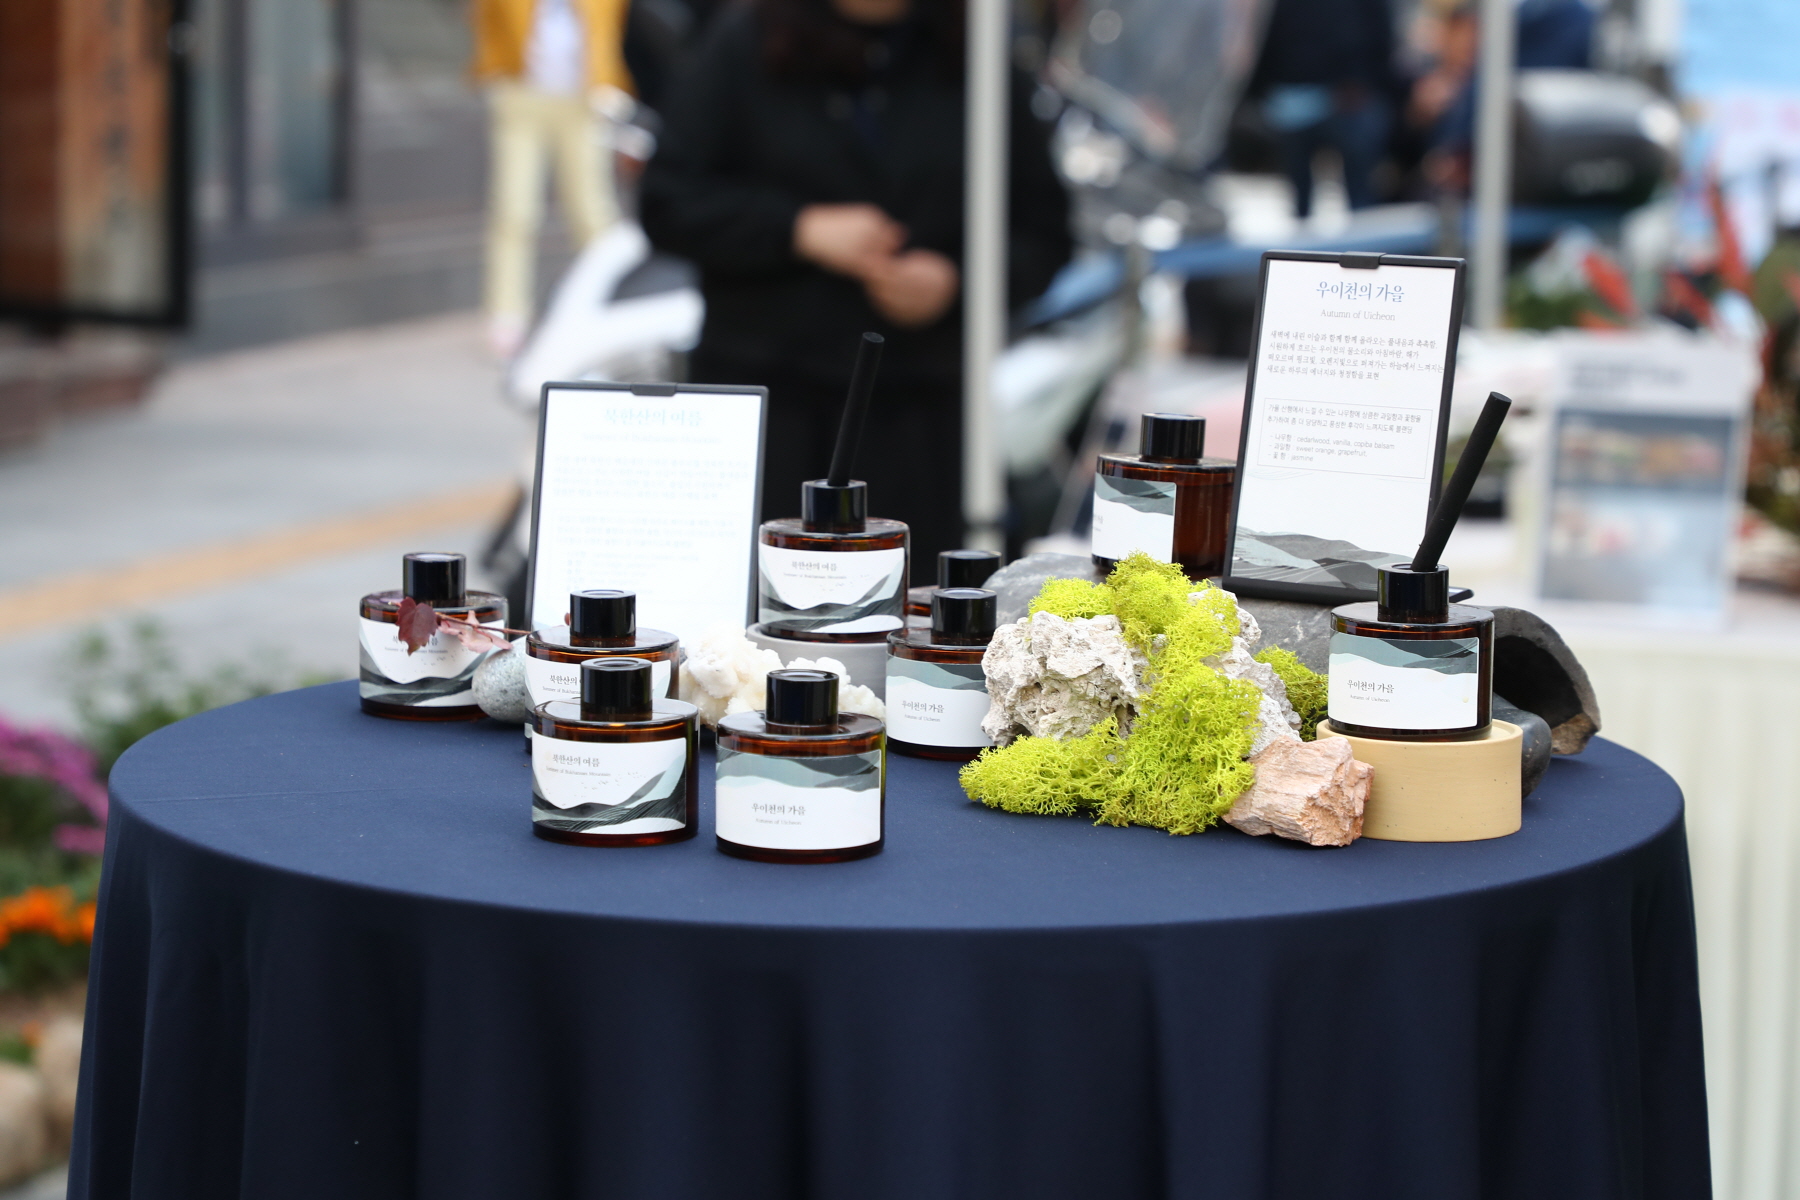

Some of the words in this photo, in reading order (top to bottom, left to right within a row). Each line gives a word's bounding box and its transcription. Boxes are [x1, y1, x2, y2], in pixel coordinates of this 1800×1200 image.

[1316, 281, 1372, 300] 우이천의
[1376, 284, 1404, 302] 가을
[1320, 309, 1350, 318] Autumn
[1353, 310, 1361, 319] of
[1364, 311, 1395, 321] Uicheon
[1271, 330, 1290, 339] 새벽에
[1292, 332, 1305, 340] 내린
[1307, 332, 1327, 341] 이슬과
[1329, 334, 1342, 343] 함께
[1344, 335, 1358, 344] 함께
[1360, 336, 1386, 346] 올라오는
[1388, 337, 1415, 347] 풀내음과
[1270, 342, 1295, 351] 시원하게
[1297, 344, 1317, 353] 흐르는
[1319, 345, 1345, 355] 우이천의
[1347, 346, 1374, 356] 물소리와
[1406, 350, 1419, 359] 해가
[1320, 357, 1358, 367] 오렌지빛으로
[1389, 361, 1415, 371] 하늘에서
[1267, 364, 1286, 374] 새로운
[1288, 366, 1308, 375] 하루의
[1310, 368, 1336, 377] 에너지와
[1339, 369, 1364, 380] 청정함을
[1366, 372, 1380, 380] 표현
[605, 408, 666, 425] 북한산의
[670, 409, 704, 426] 여름
[1268, 404, 1280, 412] 가을
[1281, 405, 1304, 414] 산행에서
[1338, 410, 1360, 418] 나무향에
[1380, 412, 1403, 421] 과일향과
[1267, 415, 1290, 424] 추가하여
[1306, 419, 1328, 427] 당당하고
[1330, 420, 1346, 429] 풍성한
[1275, 433, 1292, 442] 나무향
[1274, 443, 1291, 451] 과일향
[792, 561, 820, 570] 북한산의
[821, 562, 837, 571] 여름
[550, 675, 577, 686] 북한산의
[1347, 679, 1375, 692] 우이천의
[1377, 683, 1395, 694] 가을
[902, 700, 927, 712] 우이천의
[928, 704, 944, 713] 가을
[552, 754, 581, 766] 북한산의
[583, 757, 600, 767] 여름
[751, 803, 785, 815] 우이천의
[788, 805, 806, 816] 가을
